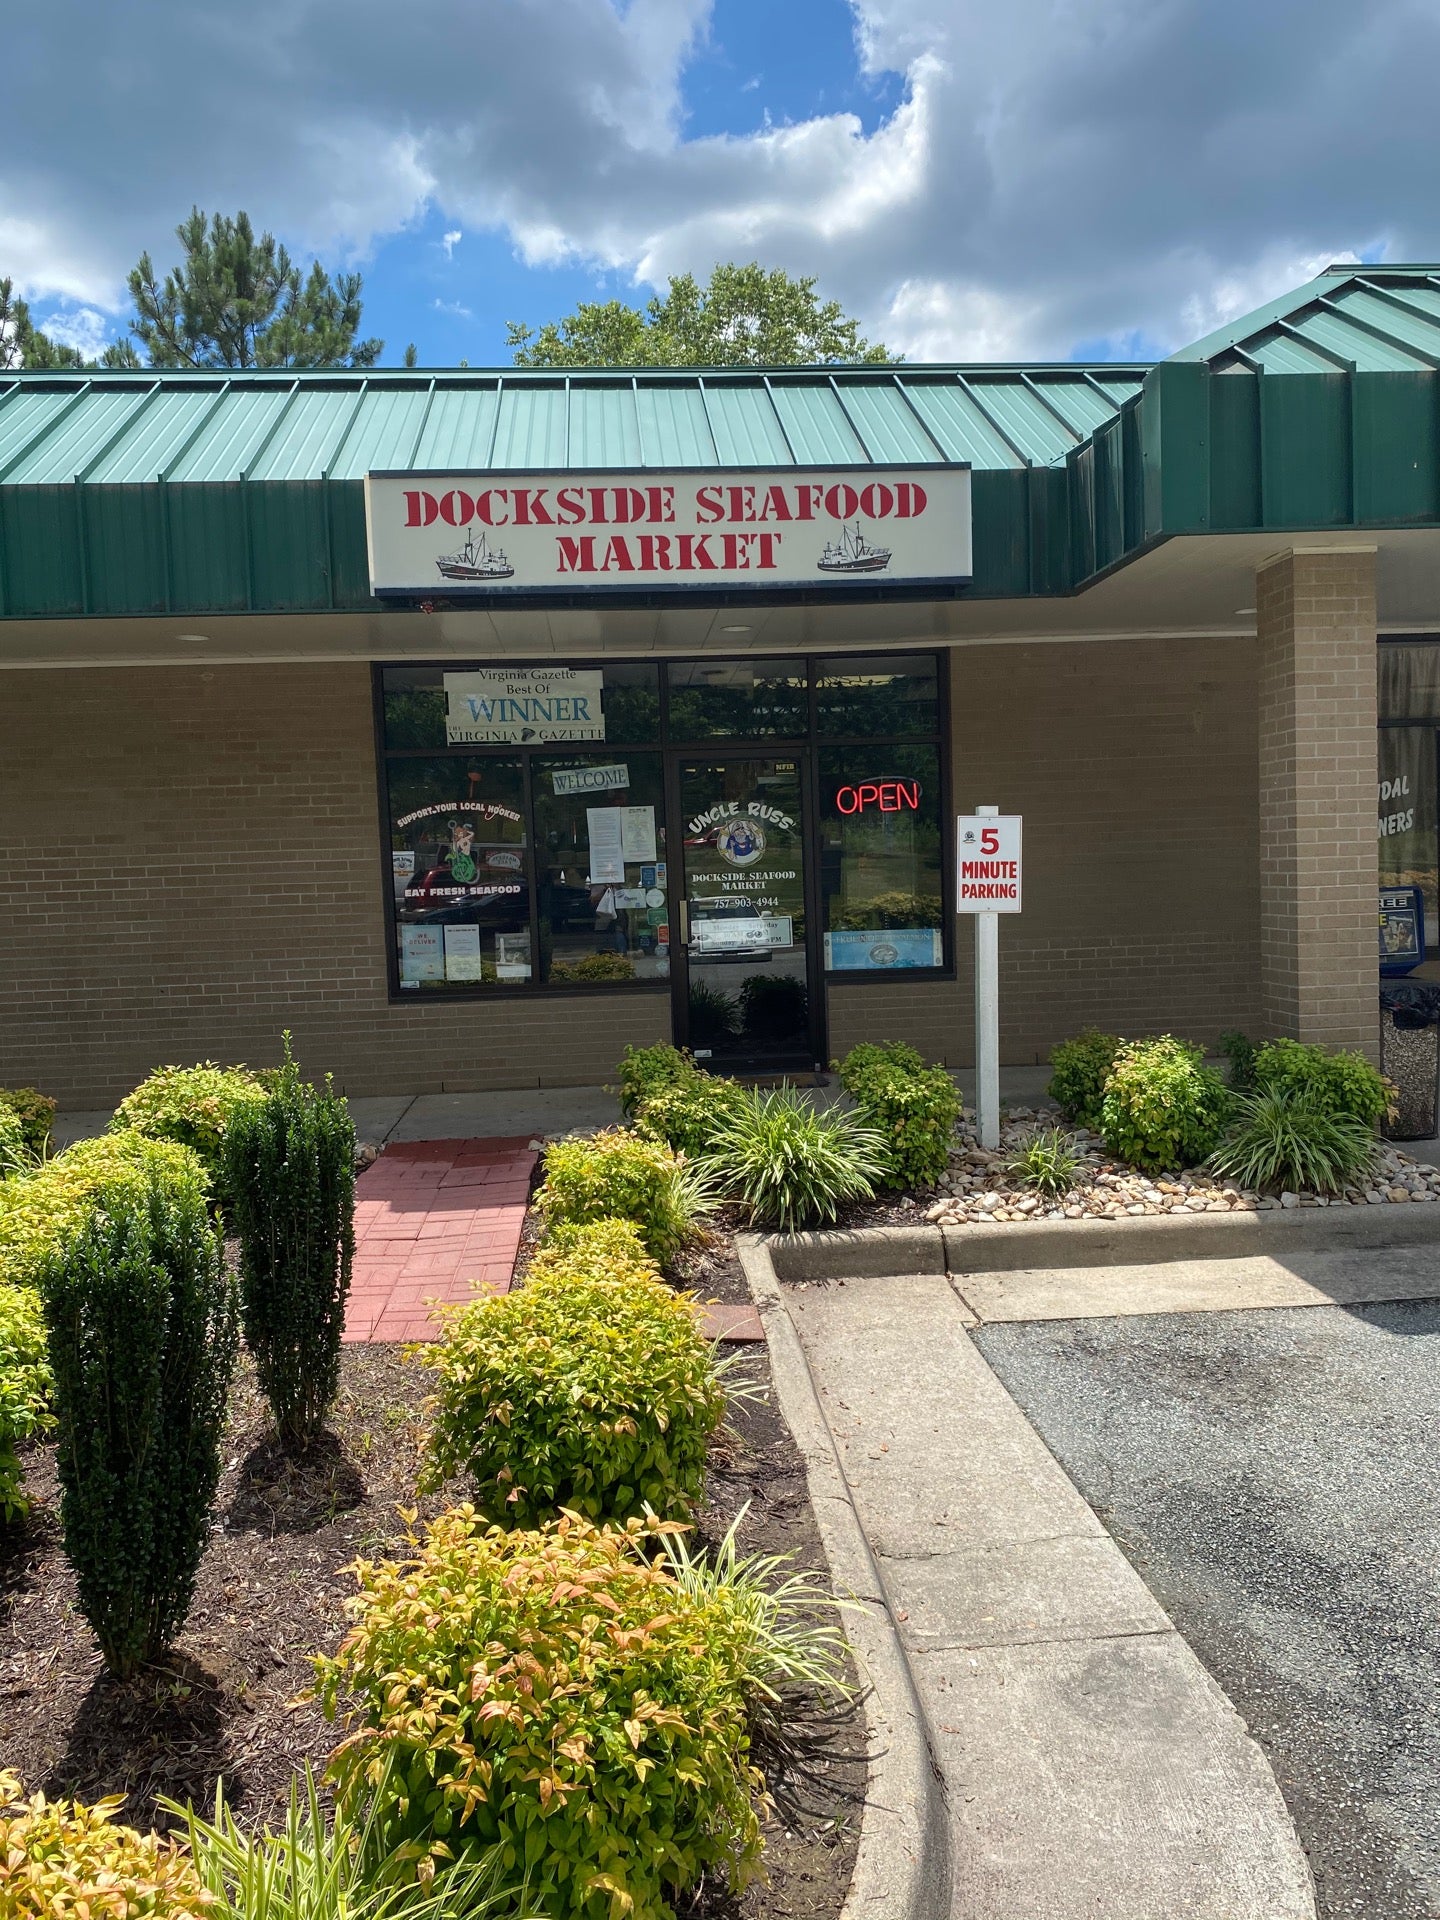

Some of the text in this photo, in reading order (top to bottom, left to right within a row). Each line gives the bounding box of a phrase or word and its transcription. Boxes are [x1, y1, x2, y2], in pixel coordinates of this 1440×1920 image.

[403, 483, 928, 527] DOCKSIDE SEAFOOD
[556, 533, 782, 573] MARKET
[479, 670, 577, 682] Virginia Gazette
[506, 683, 551, 694] Best Of
[468, 697, 591, 722] WINNER
[449, 729, 604, 741] VIRGINIA GAZETTE
[554, 769, 626, 791] WELCOME
[836, 782, 918, 814] OPEN
[397, 802, 521, 828] SUPPORT YOUR LOCAL HOOKER
[688, 802, 797, 833] UNCLE RUSS'
[980, 828, 1000, 855] 5
[692, 871, 796, 882] DOCKSIDE SEAFOOD
[961, 861, 1017, 879] MINUTE
[404, 885, 521, 897] EAT FRESH SEAFOOD
[722, 881, 767, 890] MARKET
[961, 883, 1017, 899] PARKING
[714, 897, 779, 909] 757-903-4944
